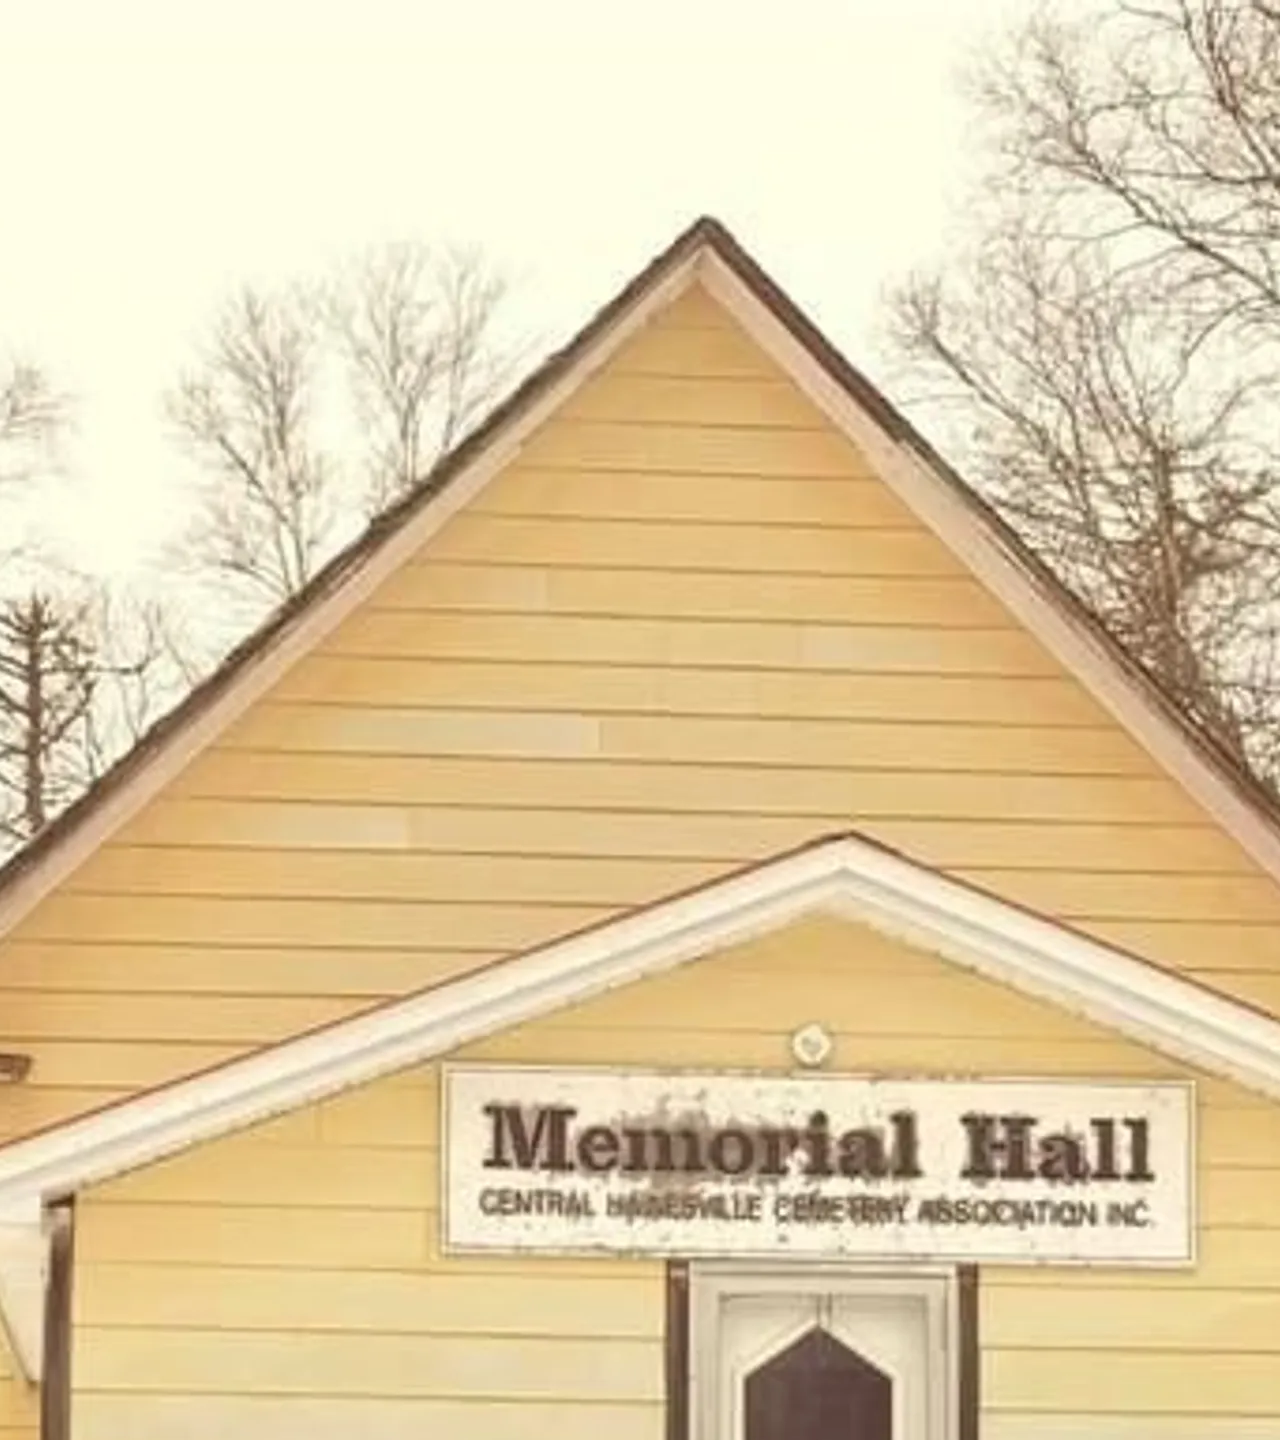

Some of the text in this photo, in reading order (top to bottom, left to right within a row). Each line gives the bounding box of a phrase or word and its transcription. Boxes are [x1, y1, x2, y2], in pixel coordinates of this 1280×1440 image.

[483, 1103, 1154, 1182] Memorial Hall
[479, 1188, 595, 1216] CENTRAL
[917, 1198, 1097, 1228] ASSOCIATION
